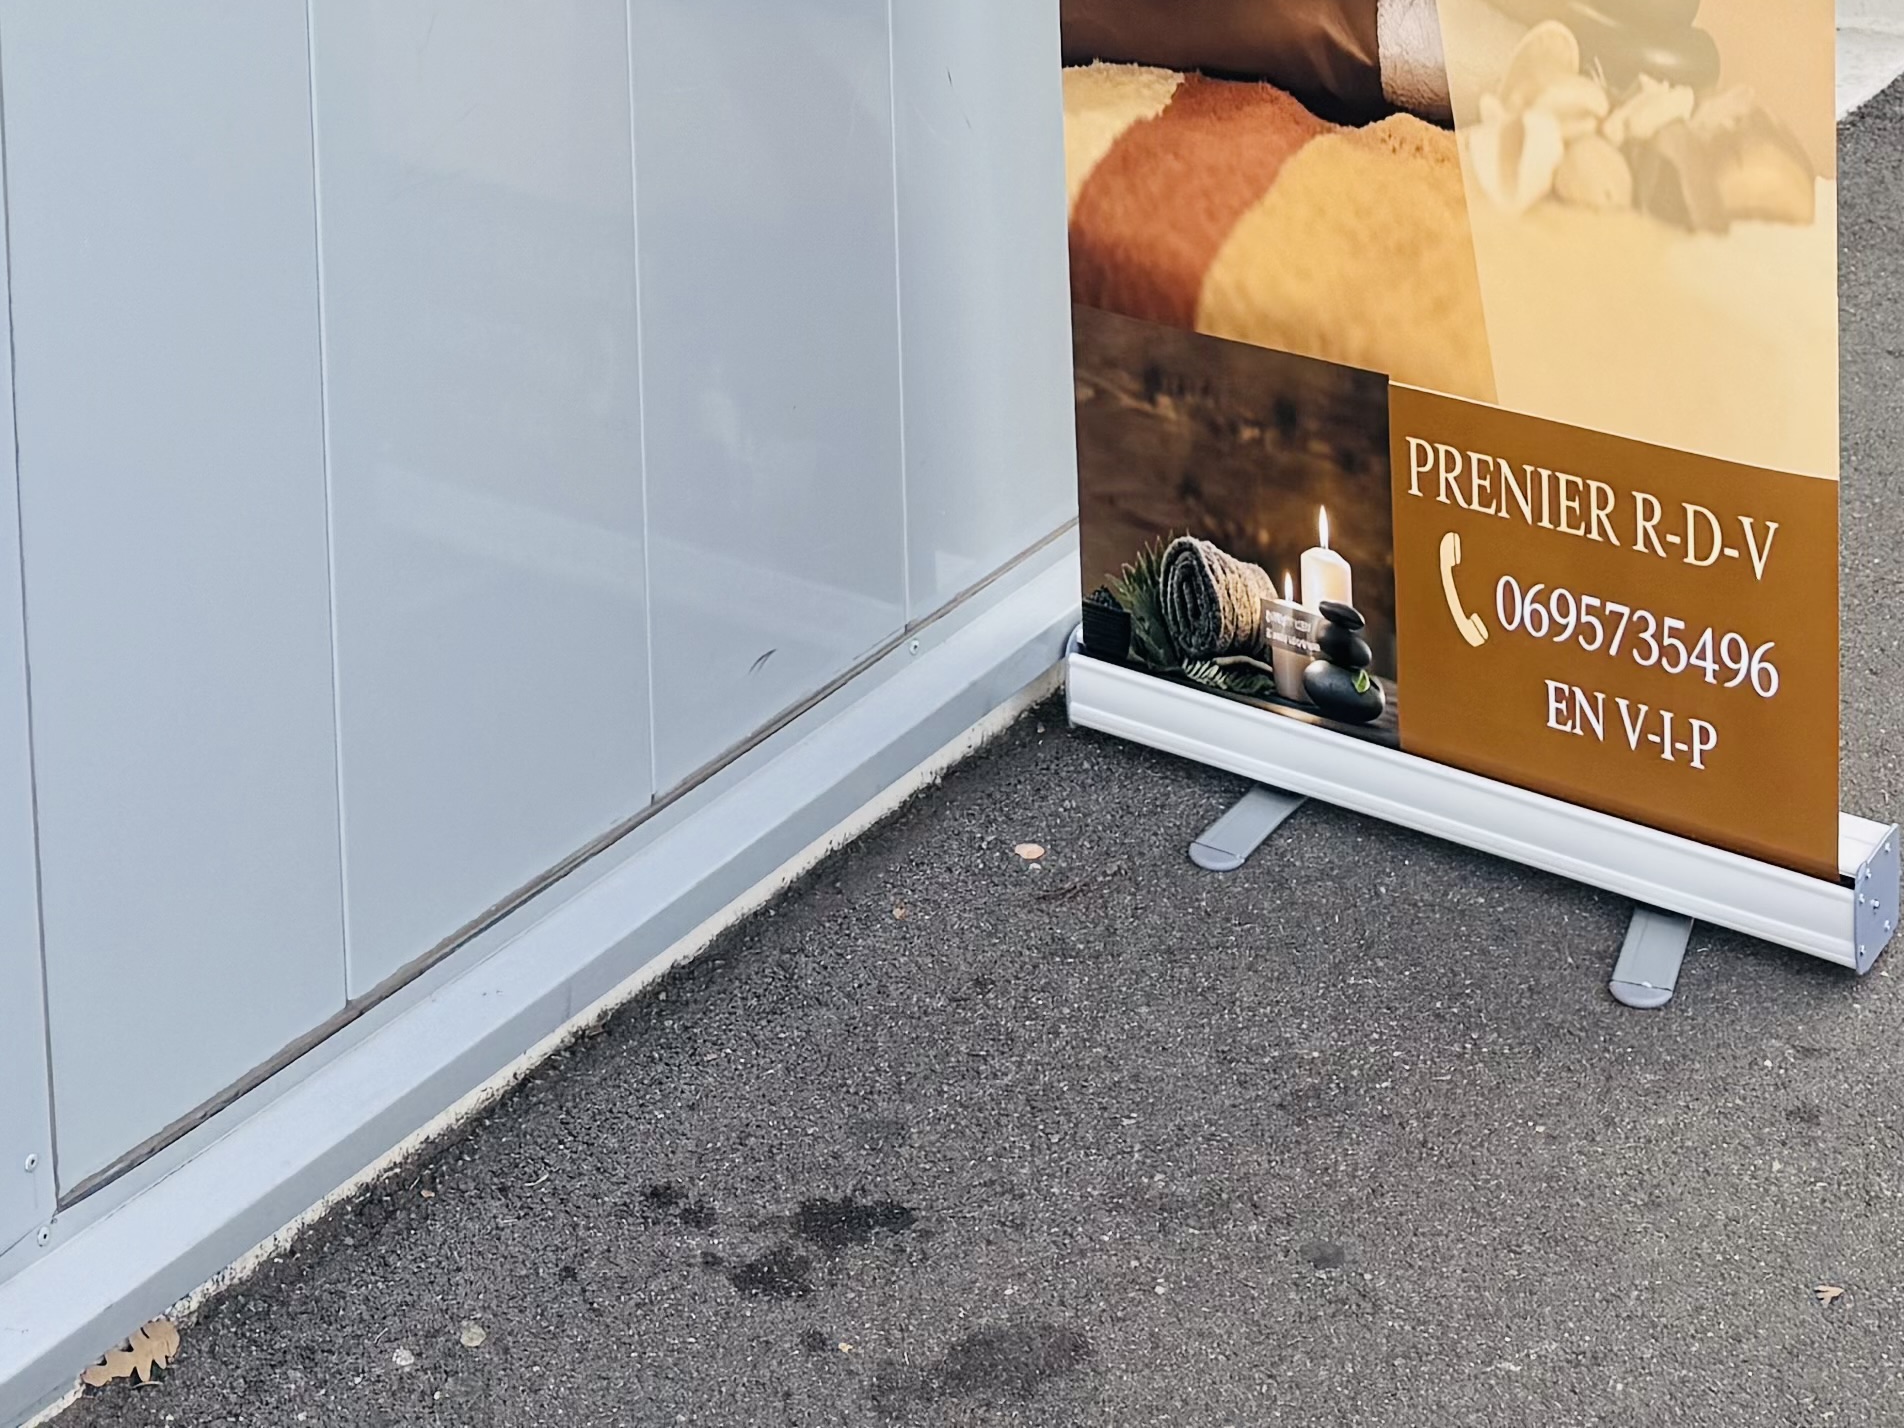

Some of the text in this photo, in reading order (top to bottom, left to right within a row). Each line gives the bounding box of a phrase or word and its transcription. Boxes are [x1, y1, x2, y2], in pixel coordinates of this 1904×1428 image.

[1404, 435, 1779, 582] PRENIER R-D-V
[1495, 574, 1780, 699] 0695735496
[1544, 679, 1718, 770] EN V-I-P
